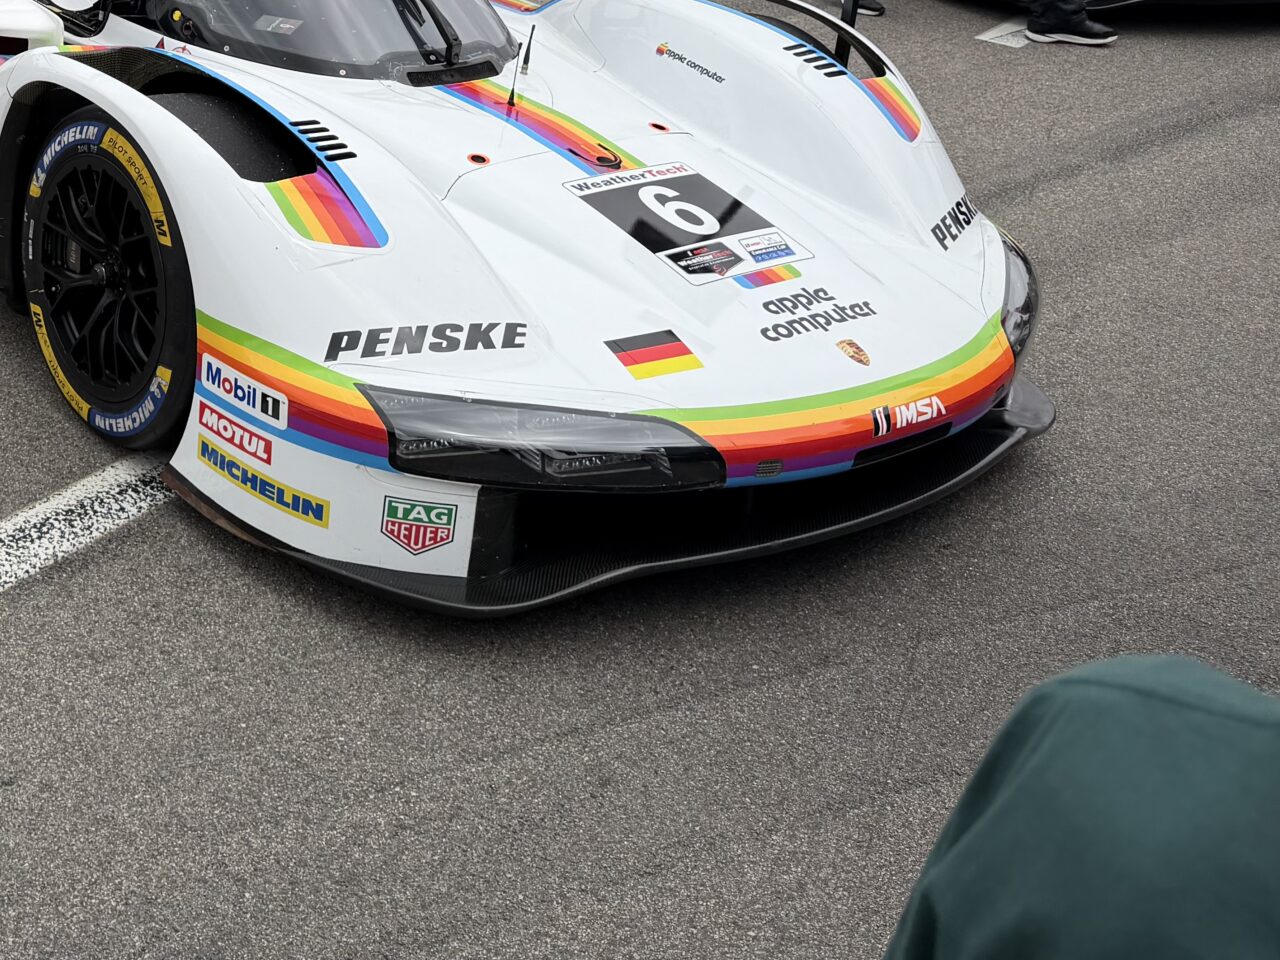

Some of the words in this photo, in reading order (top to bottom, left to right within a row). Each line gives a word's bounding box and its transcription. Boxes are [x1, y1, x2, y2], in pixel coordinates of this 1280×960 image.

[665, 46, 686, 65] apple
[686, 60, 726, 84] computer
[42, 125, 99, 170] MICHELIN
[108, 137, 128, 157] PILOT
[126, 156, 148, 187] SPORT
[571, 164, 689, 192] WeatherTech
[638, 185, 721, 235] 6
[760, 301, 877, 342] computer
[762, 287, 837, 316] apple
[324, 321, 528, 363] PENSKE
[205, 360, 257, 409] Mobil
[262, 393, 278, 419] 1
[94, 392, 156, 434] MICHELIN
[895, 395, 947, 429] IMSA
[201, 407, 269, 461] MOTUL
[200, 441, 324, 522] MICHELIN
[391, 502, 449, 524] TAG
[387, 522, 449, 553] HEUER
